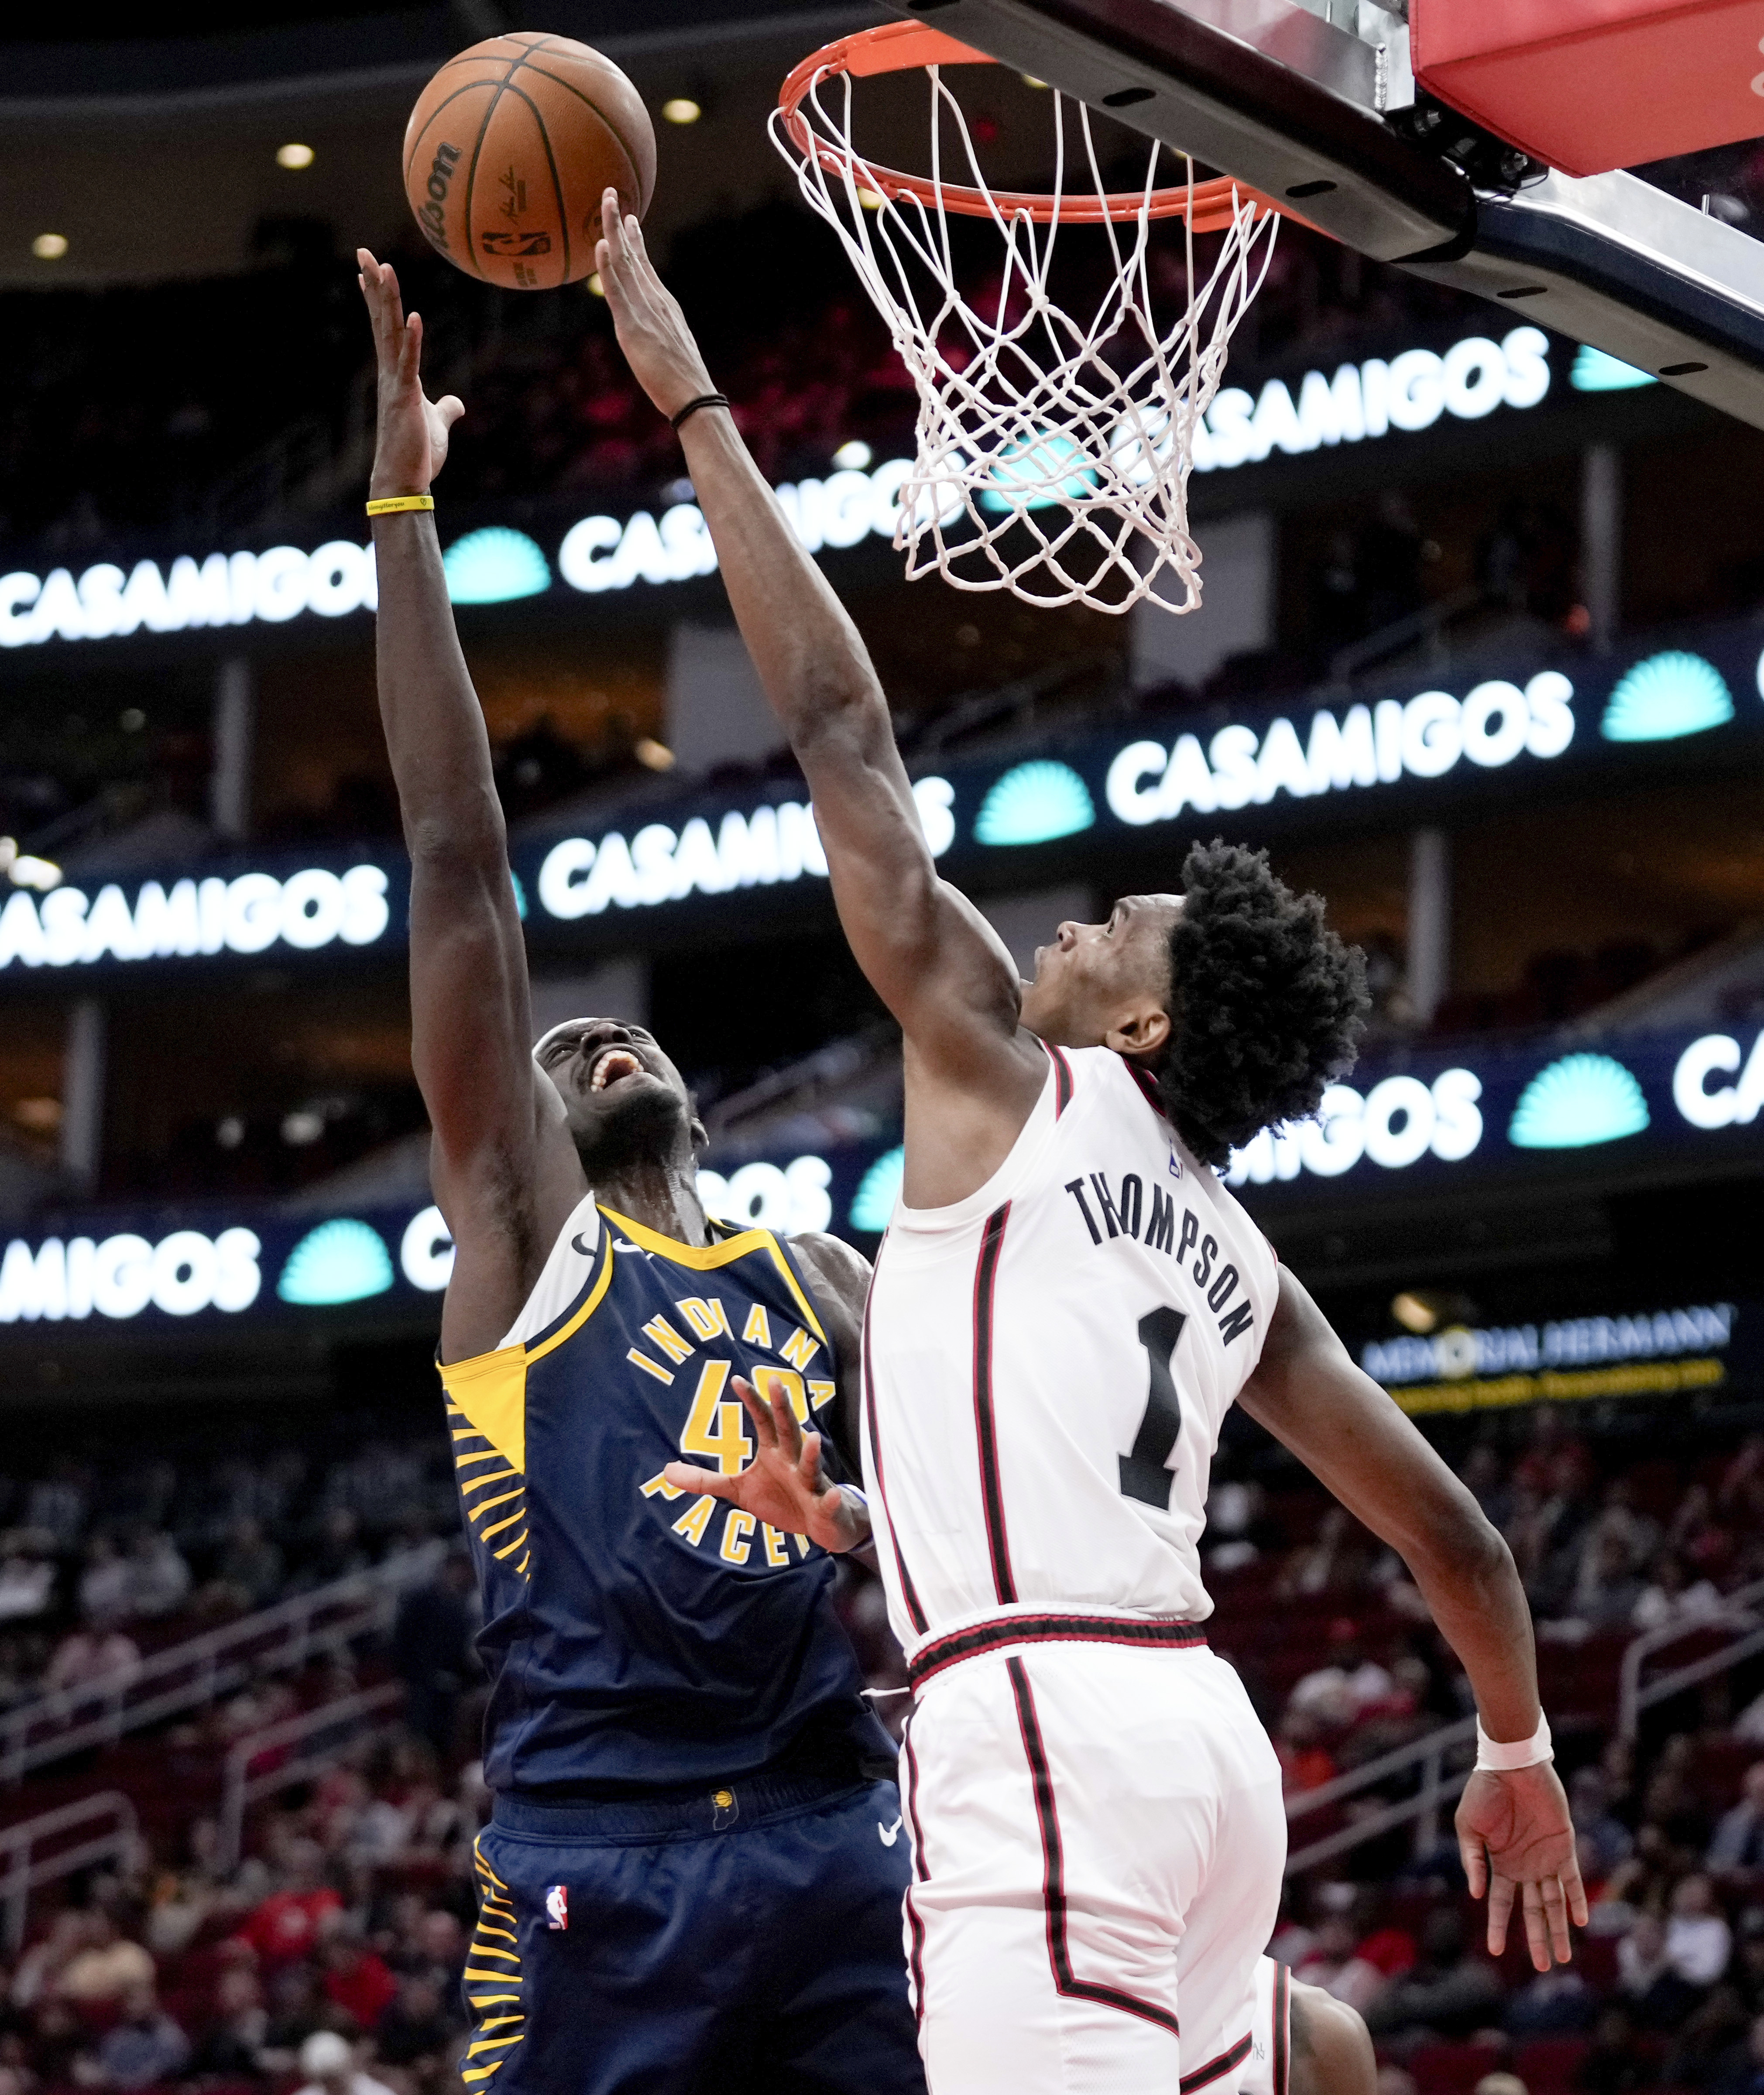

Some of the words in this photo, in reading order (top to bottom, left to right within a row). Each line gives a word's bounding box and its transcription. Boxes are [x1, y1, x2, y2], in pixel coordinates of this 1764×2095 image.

[1106, 671, 1575, 825] CASAMIGOS
[1064, 1172, 1254, 1347] THOMPSON
[626, 1297, 836, 1411] INDIANA
[1117, 1303, 1190, 1514] 1
